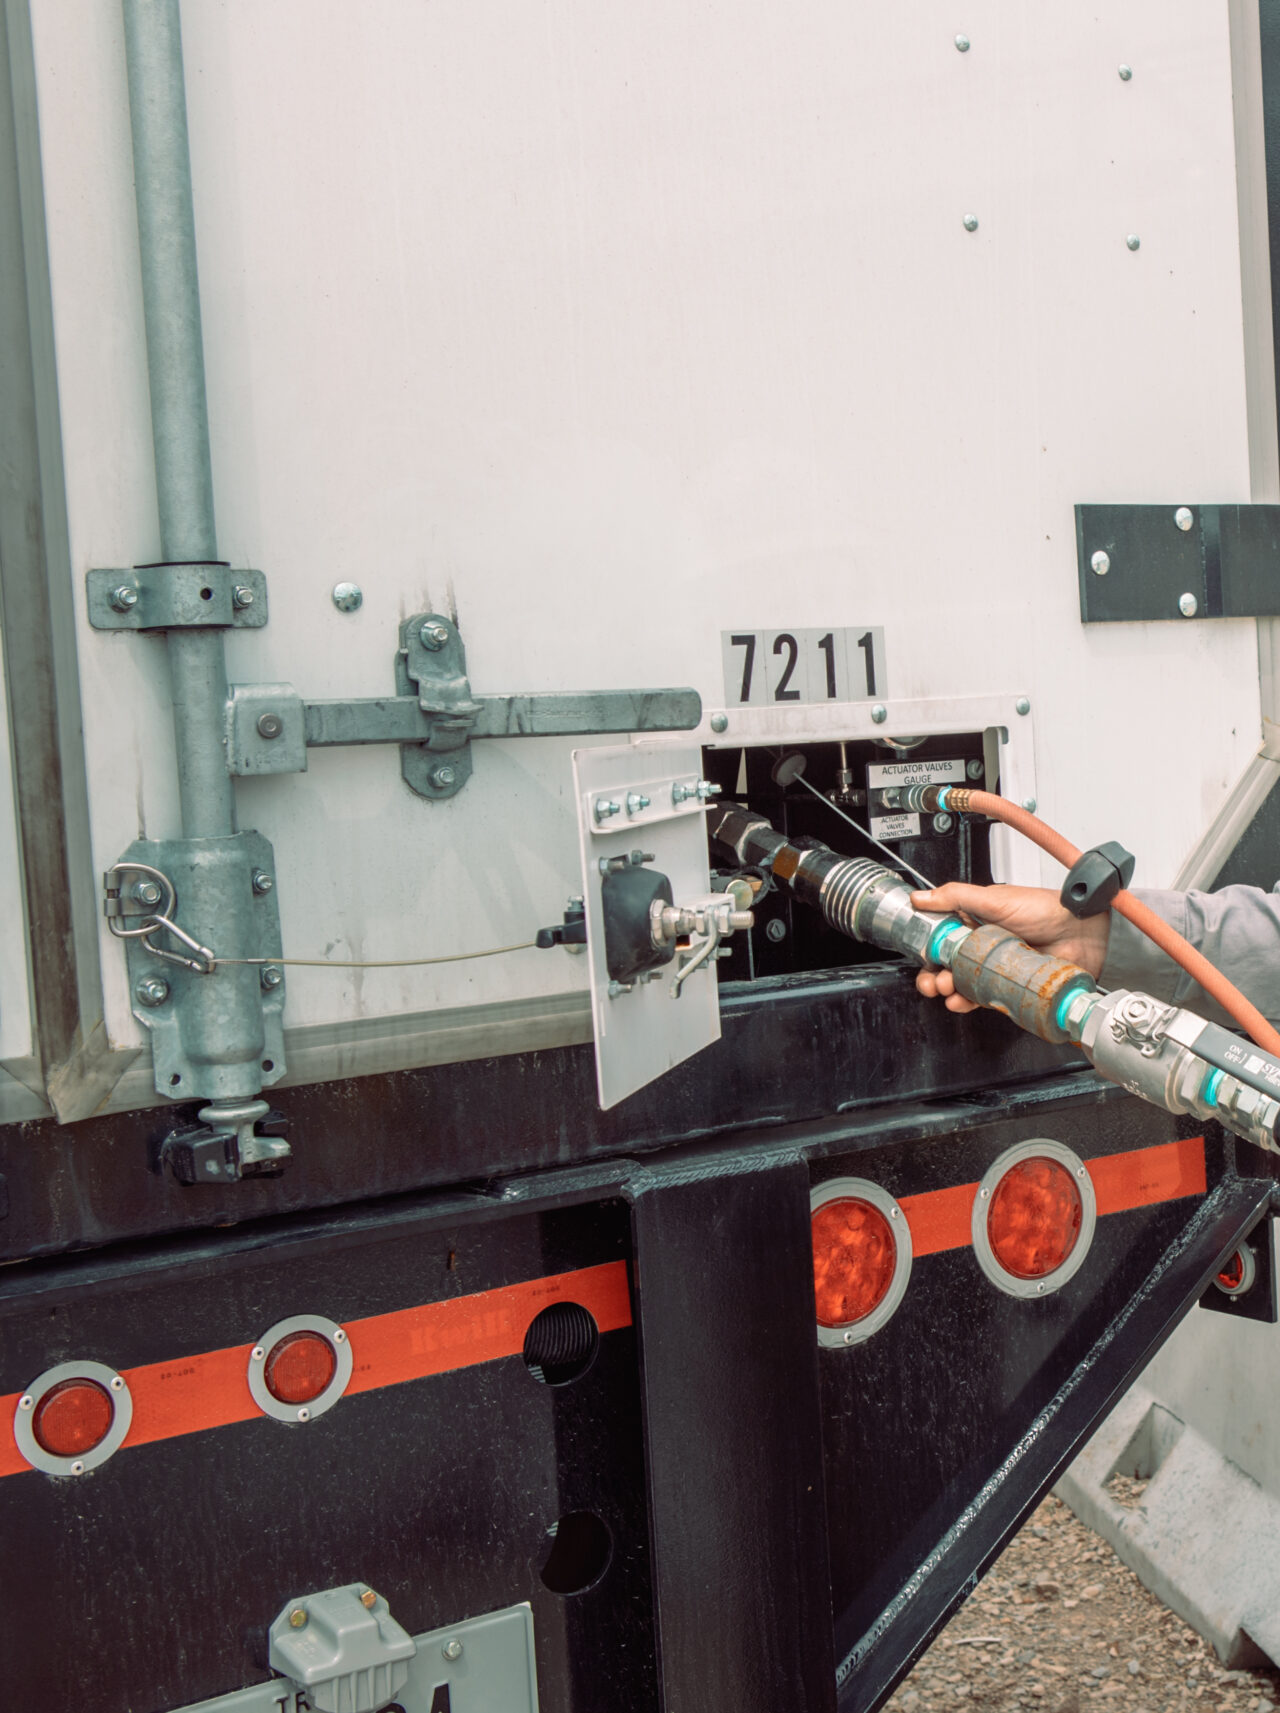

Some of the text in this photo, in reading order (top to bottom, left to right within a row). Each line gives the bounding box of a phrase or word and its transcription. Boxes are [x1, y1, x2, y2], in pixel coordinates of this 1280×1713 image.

[730, 631, 877, 702] 7211
[882, 762, 953, 775] ACTUATOR VALVES
[904, 775, 932, 785] GAUGE
[881, 815, 908, 824] ACTUATOR
[879, 829, 913, 839] CONNECTION
[1229, 1044, 1243, 1056] ON
[1224, 1051, 1241, 1063] OFF
